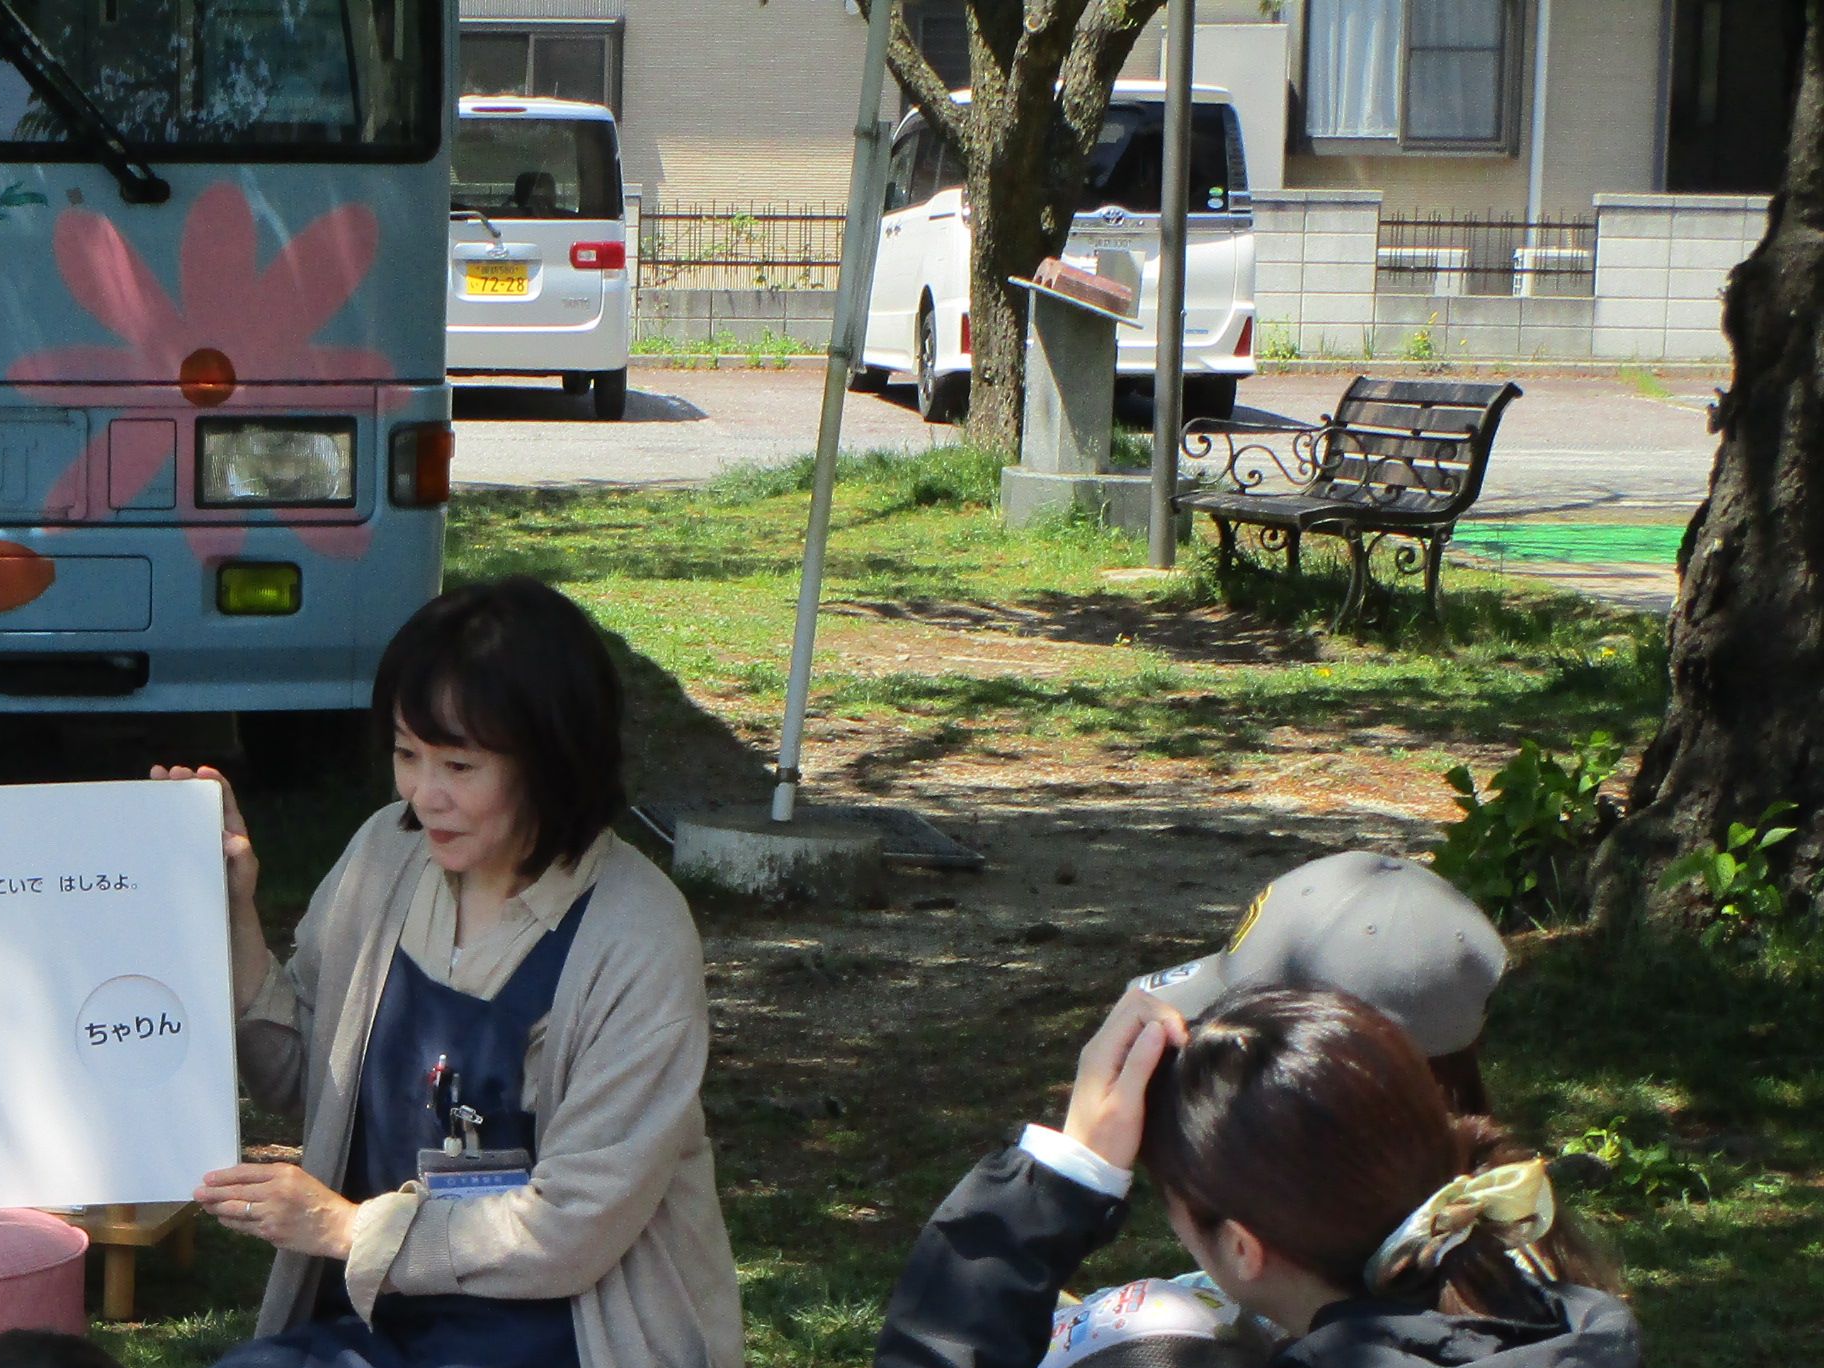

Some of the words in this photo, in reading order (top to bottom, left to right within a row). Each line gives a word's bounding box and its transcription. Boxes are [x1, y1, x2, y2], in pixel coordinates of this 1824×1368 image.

[480, 276, 525, 293] 72-28
[59, 873, 139, 893] はしるよ。
[84, 1012, 182, 1046] ちゃりん
